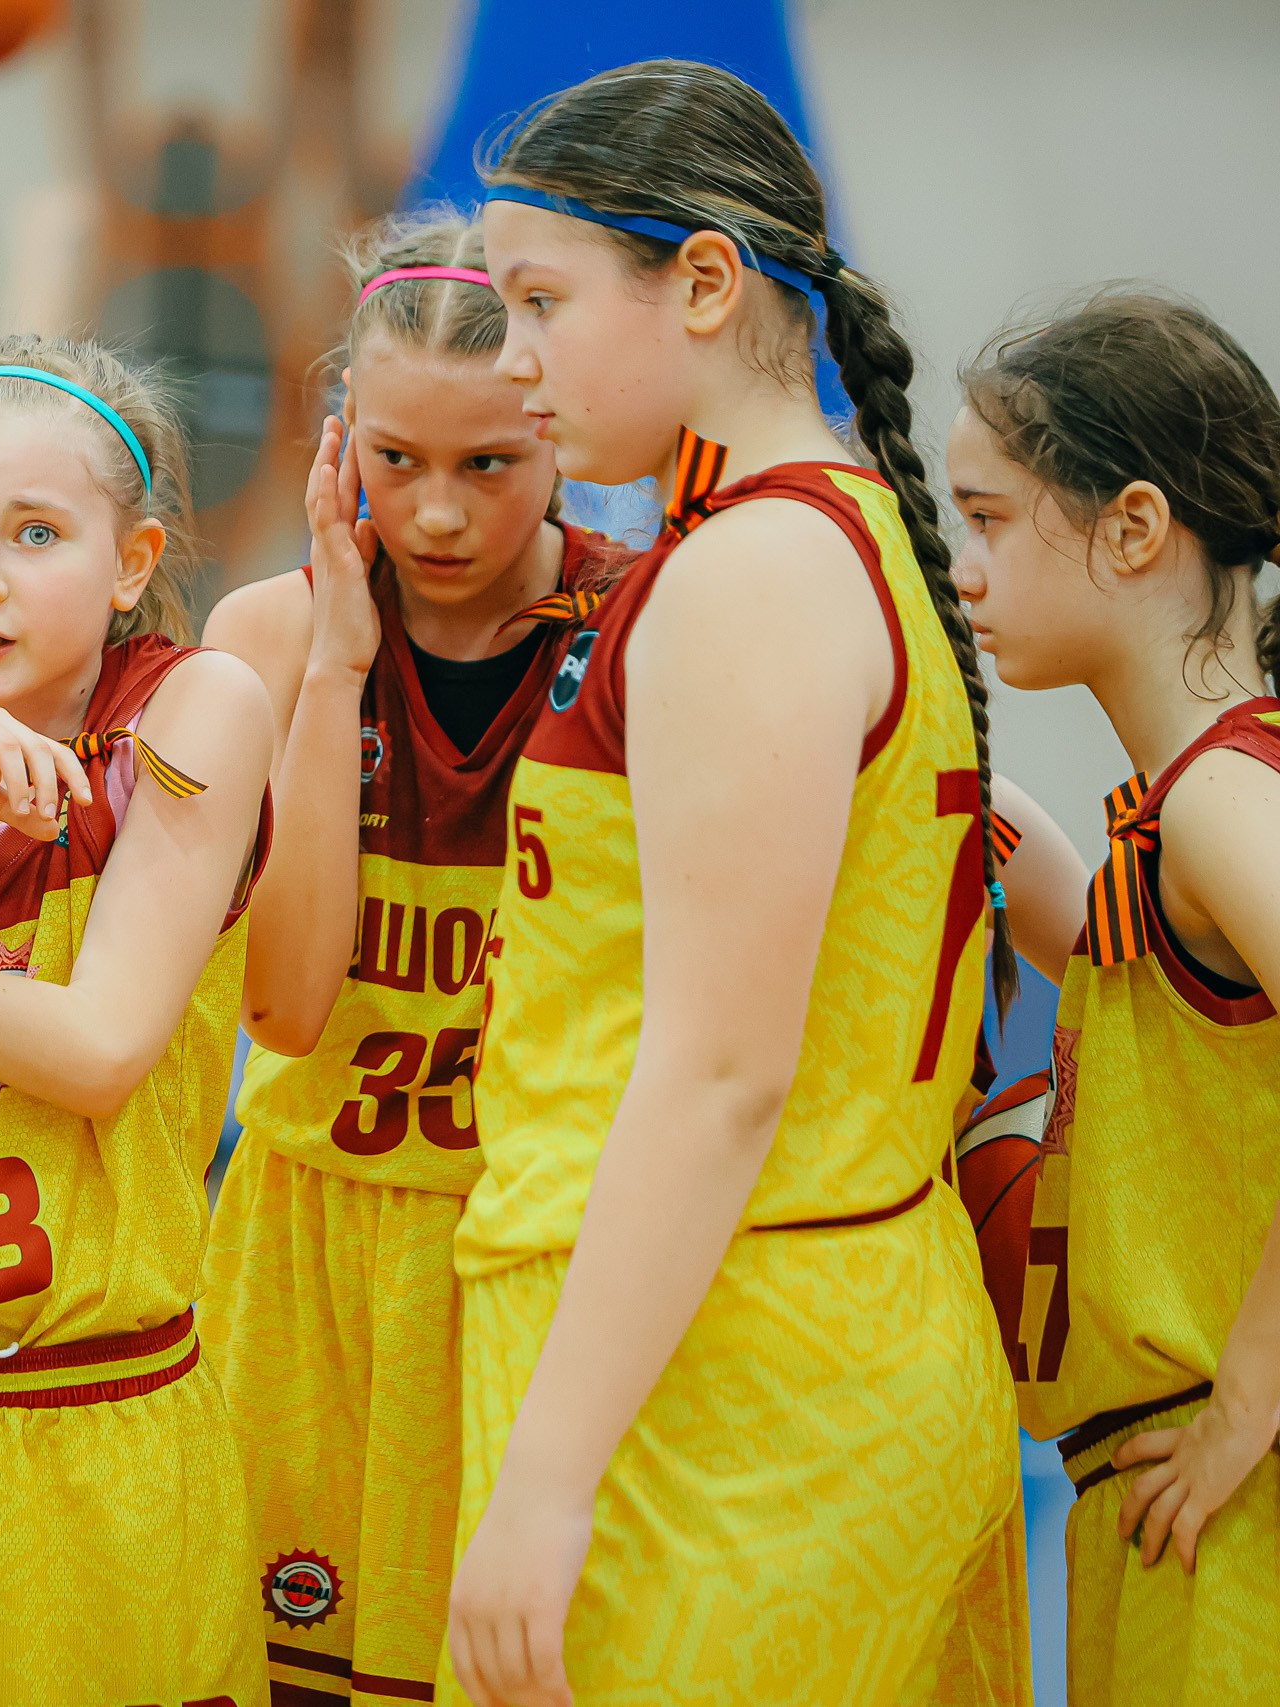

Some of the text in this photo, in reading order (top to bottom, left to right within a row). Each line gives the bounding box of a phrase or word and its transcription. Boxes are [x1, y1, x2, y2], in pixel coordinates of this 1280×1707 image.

[360, 814, 389, 828] ORT
[514, 805, 552, 900] 5
[331, 1027, 481, 1156] 35
